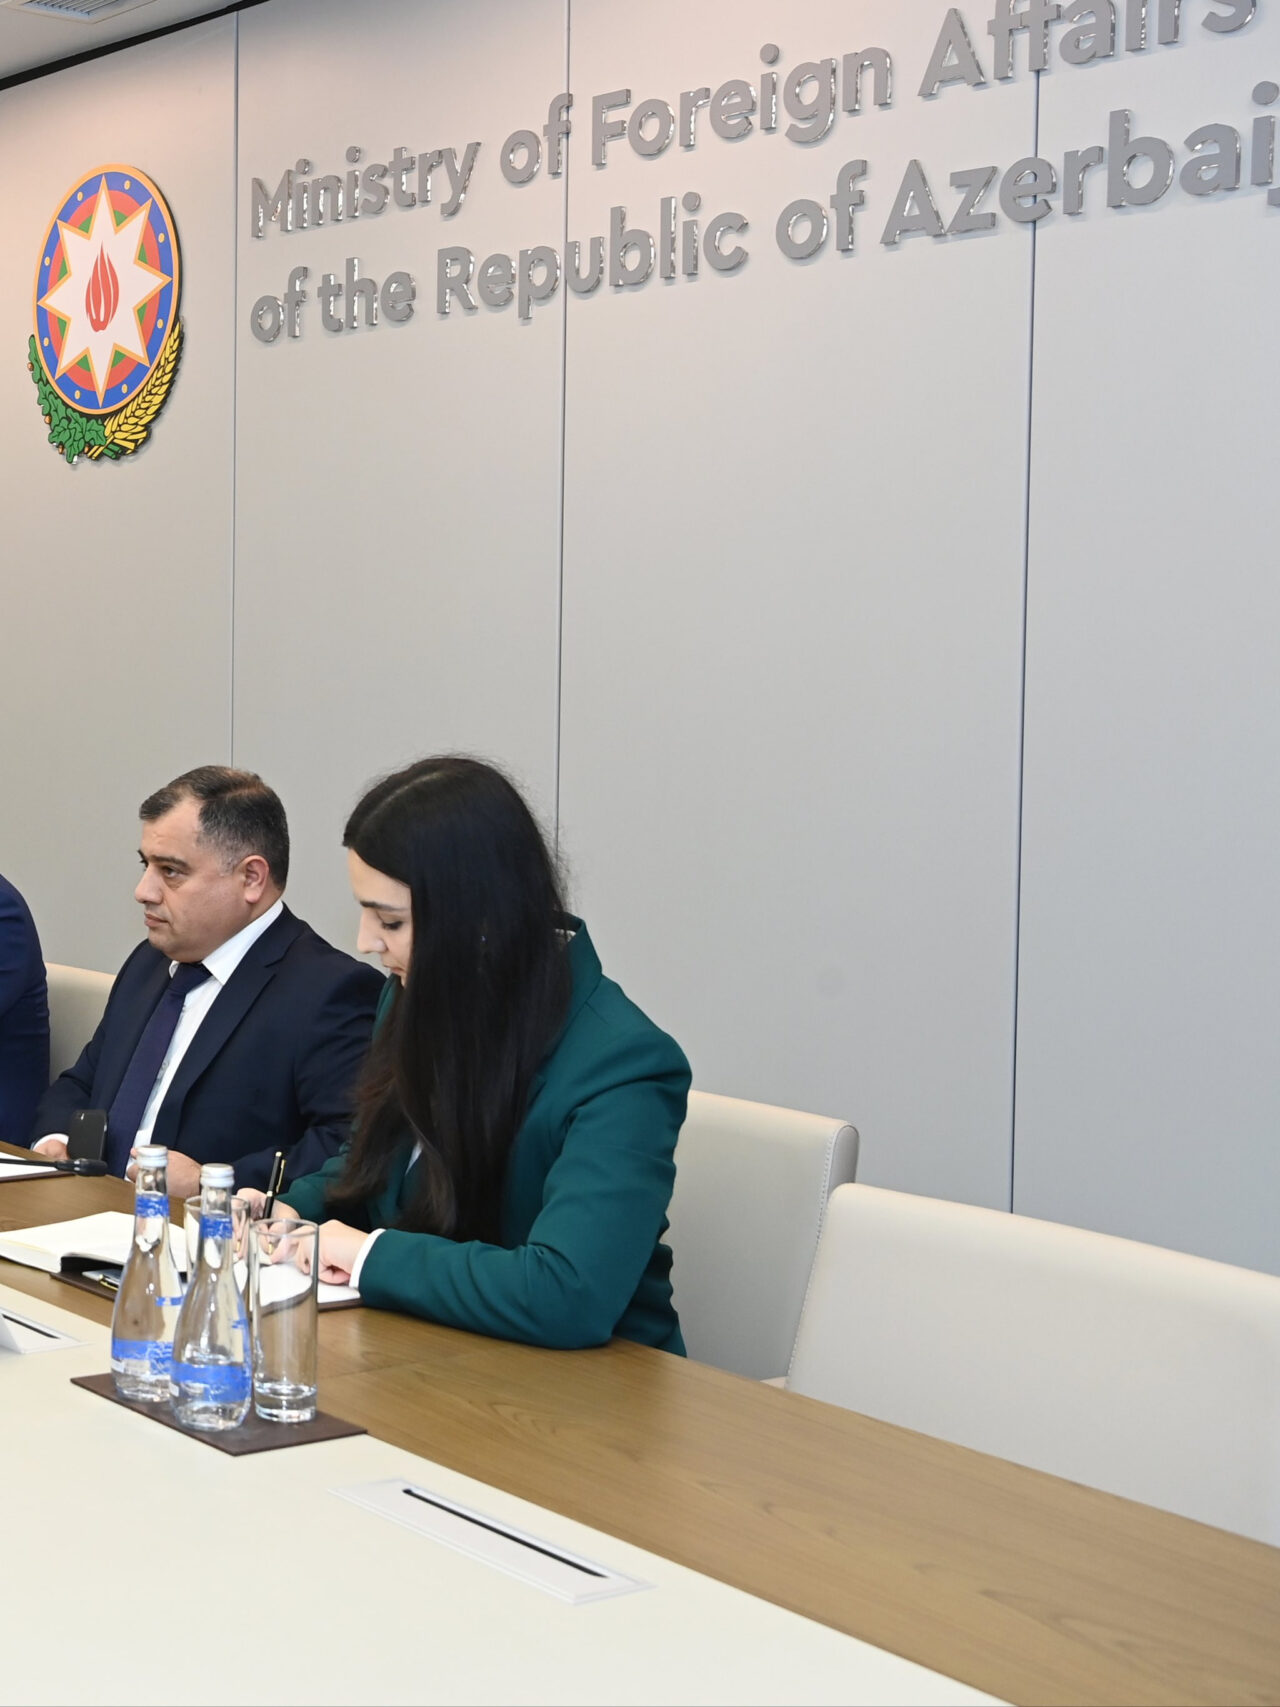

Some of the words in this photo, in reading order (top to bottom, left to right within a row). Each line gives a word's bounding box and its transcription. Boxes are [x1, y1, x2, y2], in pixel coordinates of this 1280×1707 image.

[250, 266, 309, 344] of
[317, 257, 417, 333] the
[436, 191, 750, 320] Republic
[775, 159, 868, 260] of
[880, 81, 1280, 246] Azerbai
[251, 142, 483, 239] Ministry
[500, 93, 574, 185] of
[591, 43, 893, 168] Foreign
